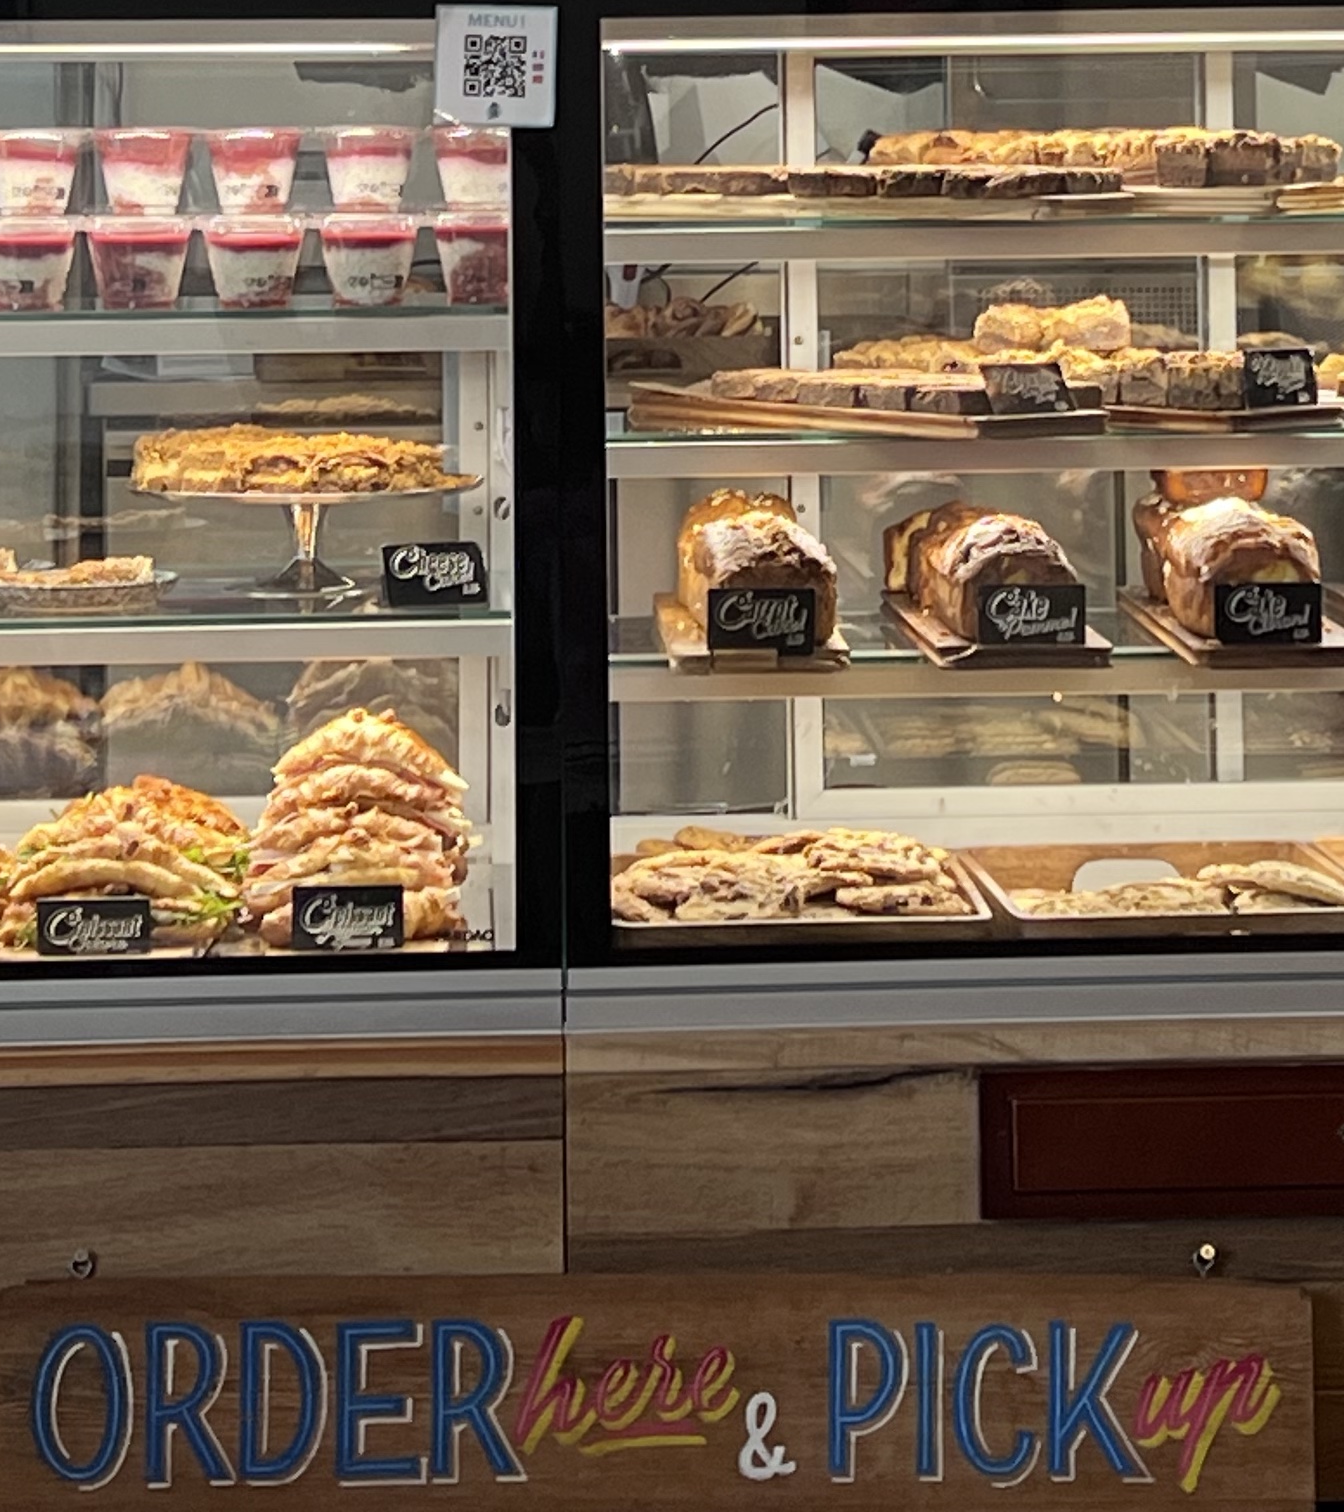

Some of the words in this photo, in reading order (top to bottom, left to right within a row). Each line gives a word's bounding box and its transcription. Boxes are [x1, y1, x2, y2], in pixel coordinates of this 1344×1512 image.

[30, 1318, 528, 1487] ORDER
[515, 1315, 741, 1455] here
[737, 1391, 798, 1481] &
[826, 1318, 1153, 1487] PICK
[1133, 1347, 1283, 1494] up
